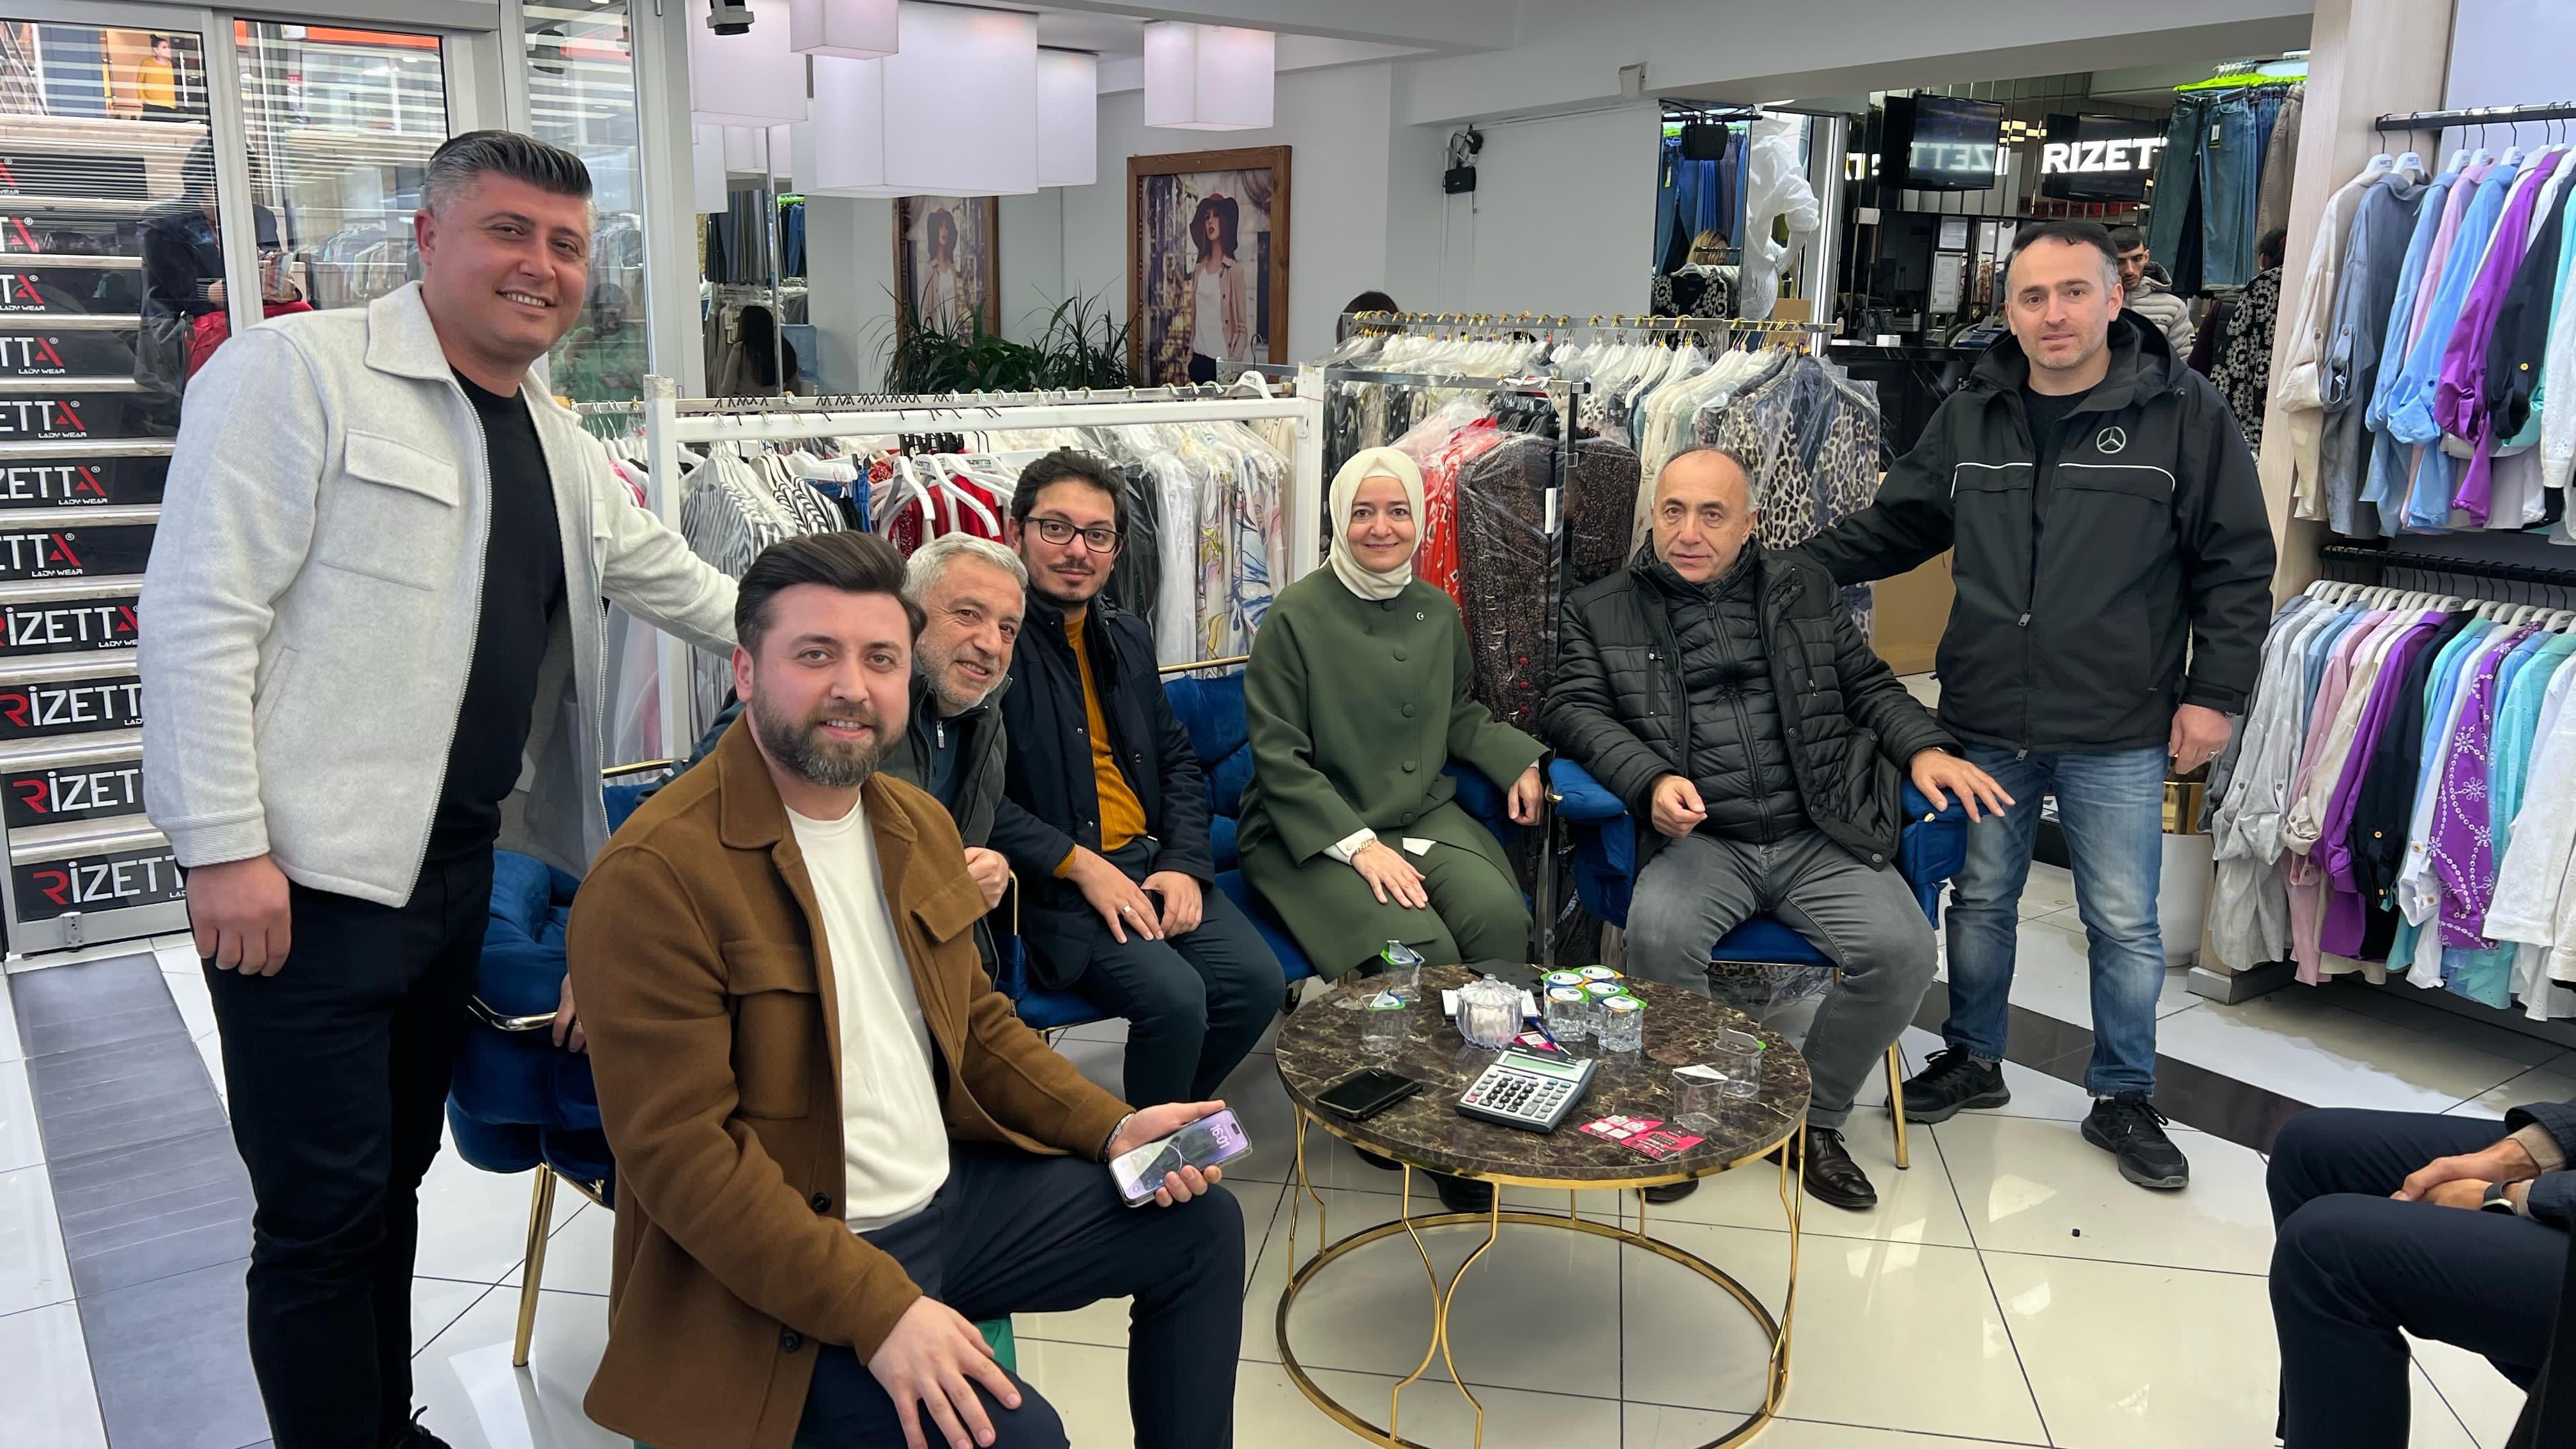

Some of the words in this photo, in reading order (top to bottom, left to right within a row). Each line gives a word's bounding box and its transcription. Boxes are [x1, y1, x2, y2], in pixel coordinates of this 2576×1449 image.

[2040, 136, 2169, 174] RIZET
[31, 569, 56, 578] LADY
[98, 640, 122, 648] LADY
[13, 770, 143, 814] RİZET
